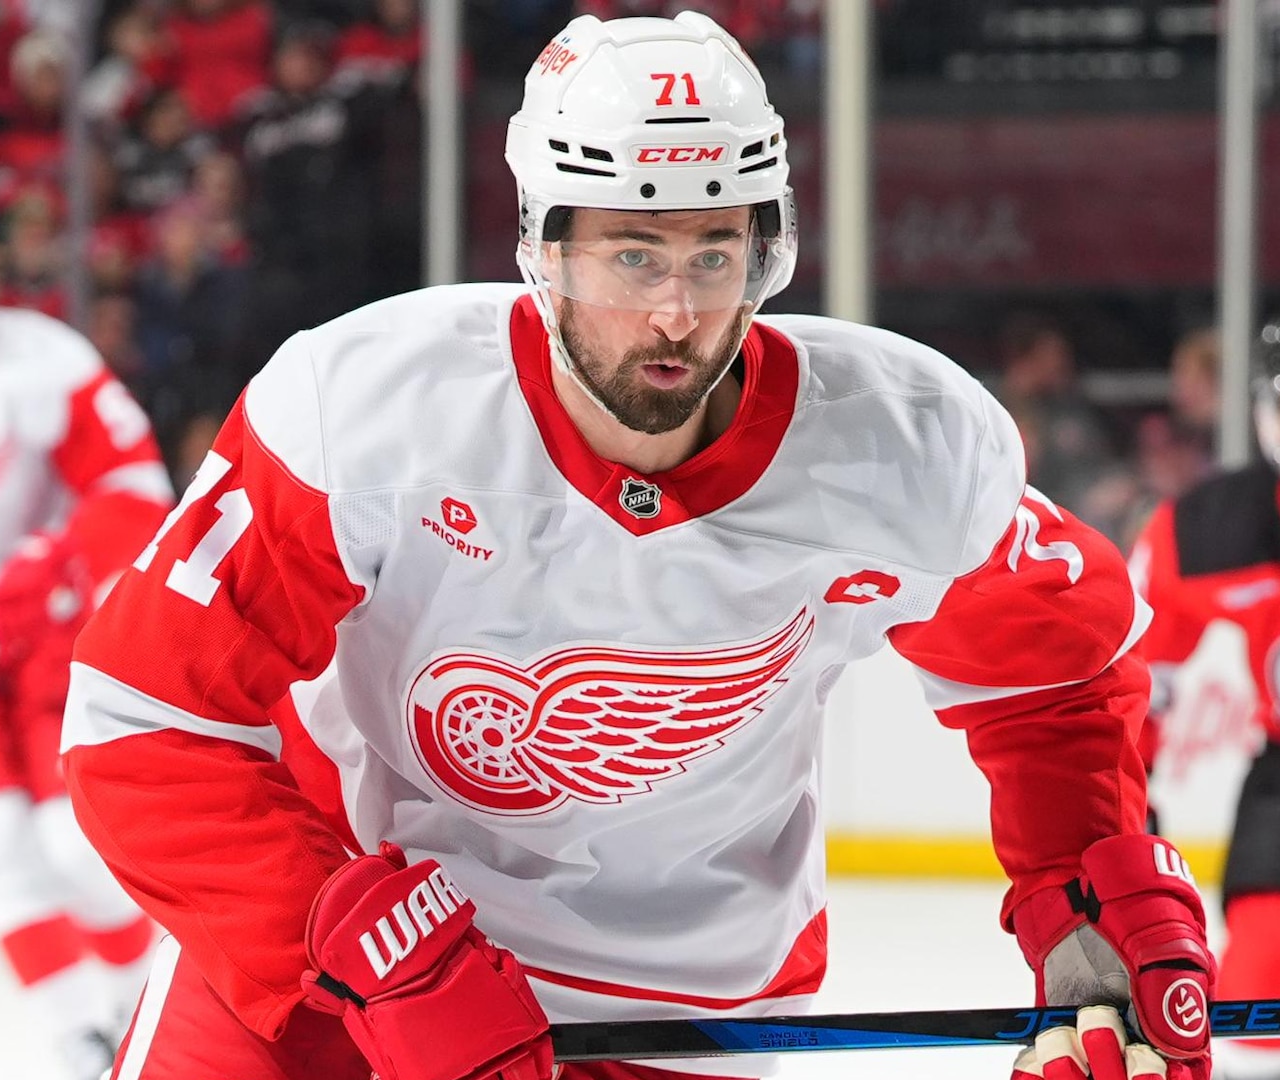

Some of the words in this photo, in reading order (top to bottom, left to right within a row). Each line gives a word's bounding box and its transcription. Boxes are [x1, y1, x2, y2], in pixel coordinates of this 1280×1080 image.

[537, 37, 578, 76] eijer
[651, 73, 700, 106] 71
[637, 146, 724, 163] CCM
[628, 492, 654, 507] NHL
[421, 517, 494, 561] PRIORITY
[823, 569, 901, 605] C
[760, 1038, 818, 1048] SHIELD
